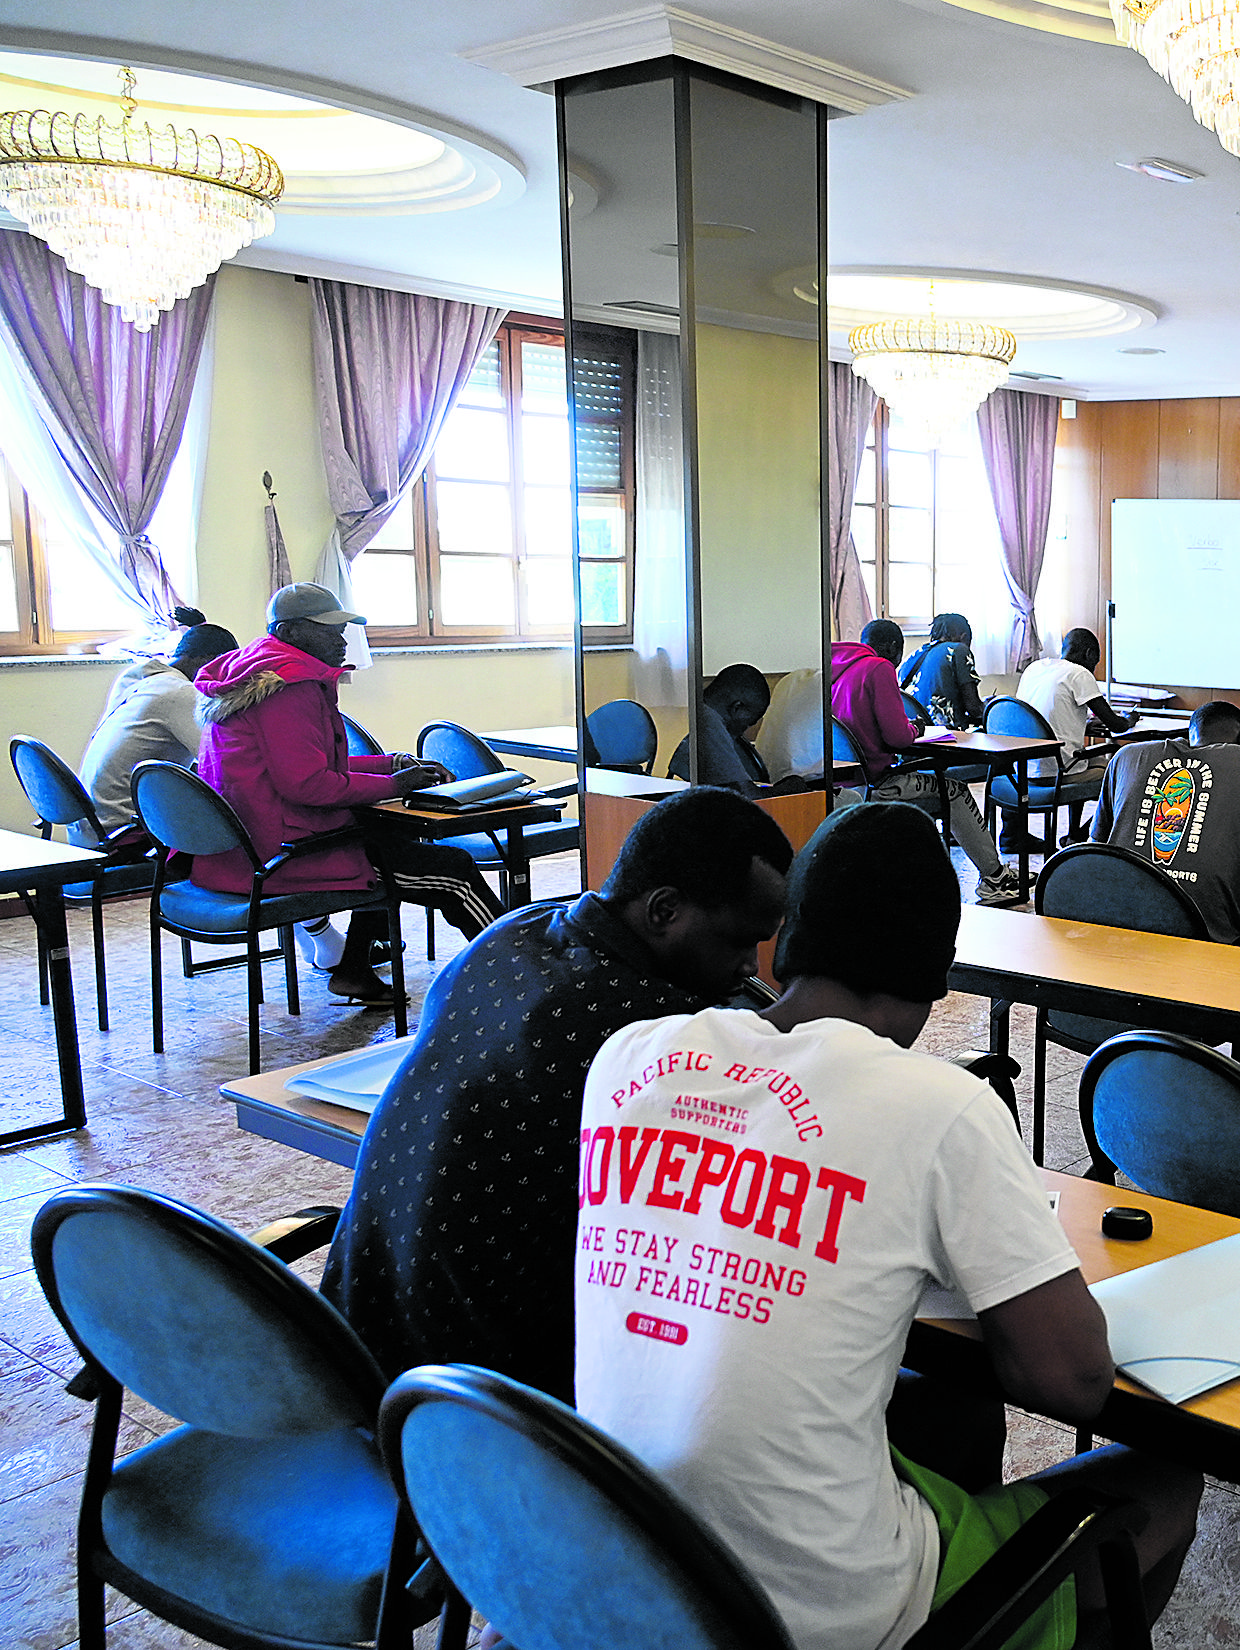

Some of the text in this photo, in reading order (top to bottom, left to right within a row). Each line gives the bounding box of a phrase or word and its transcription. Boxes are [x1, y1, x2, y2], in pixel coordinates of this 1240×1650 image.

[916, 774, 957, 797] SPOS
[1134, 758, 1213, 853] LIFE IS BETTER IN THE SUMMER
[1162, 868, 1198, 883] PORTS
[611, 1051, 824, 1142] PACIFIC REPUBLIC
[675, 1094, 749, 1120] AUTHENTIC
[671, 1107, 748, 1135] SUPPORTERS
[582, 1225, 807, 1297] WE STAY STRONG
[587, 1260, 774, 1324] AND FEARLESS
